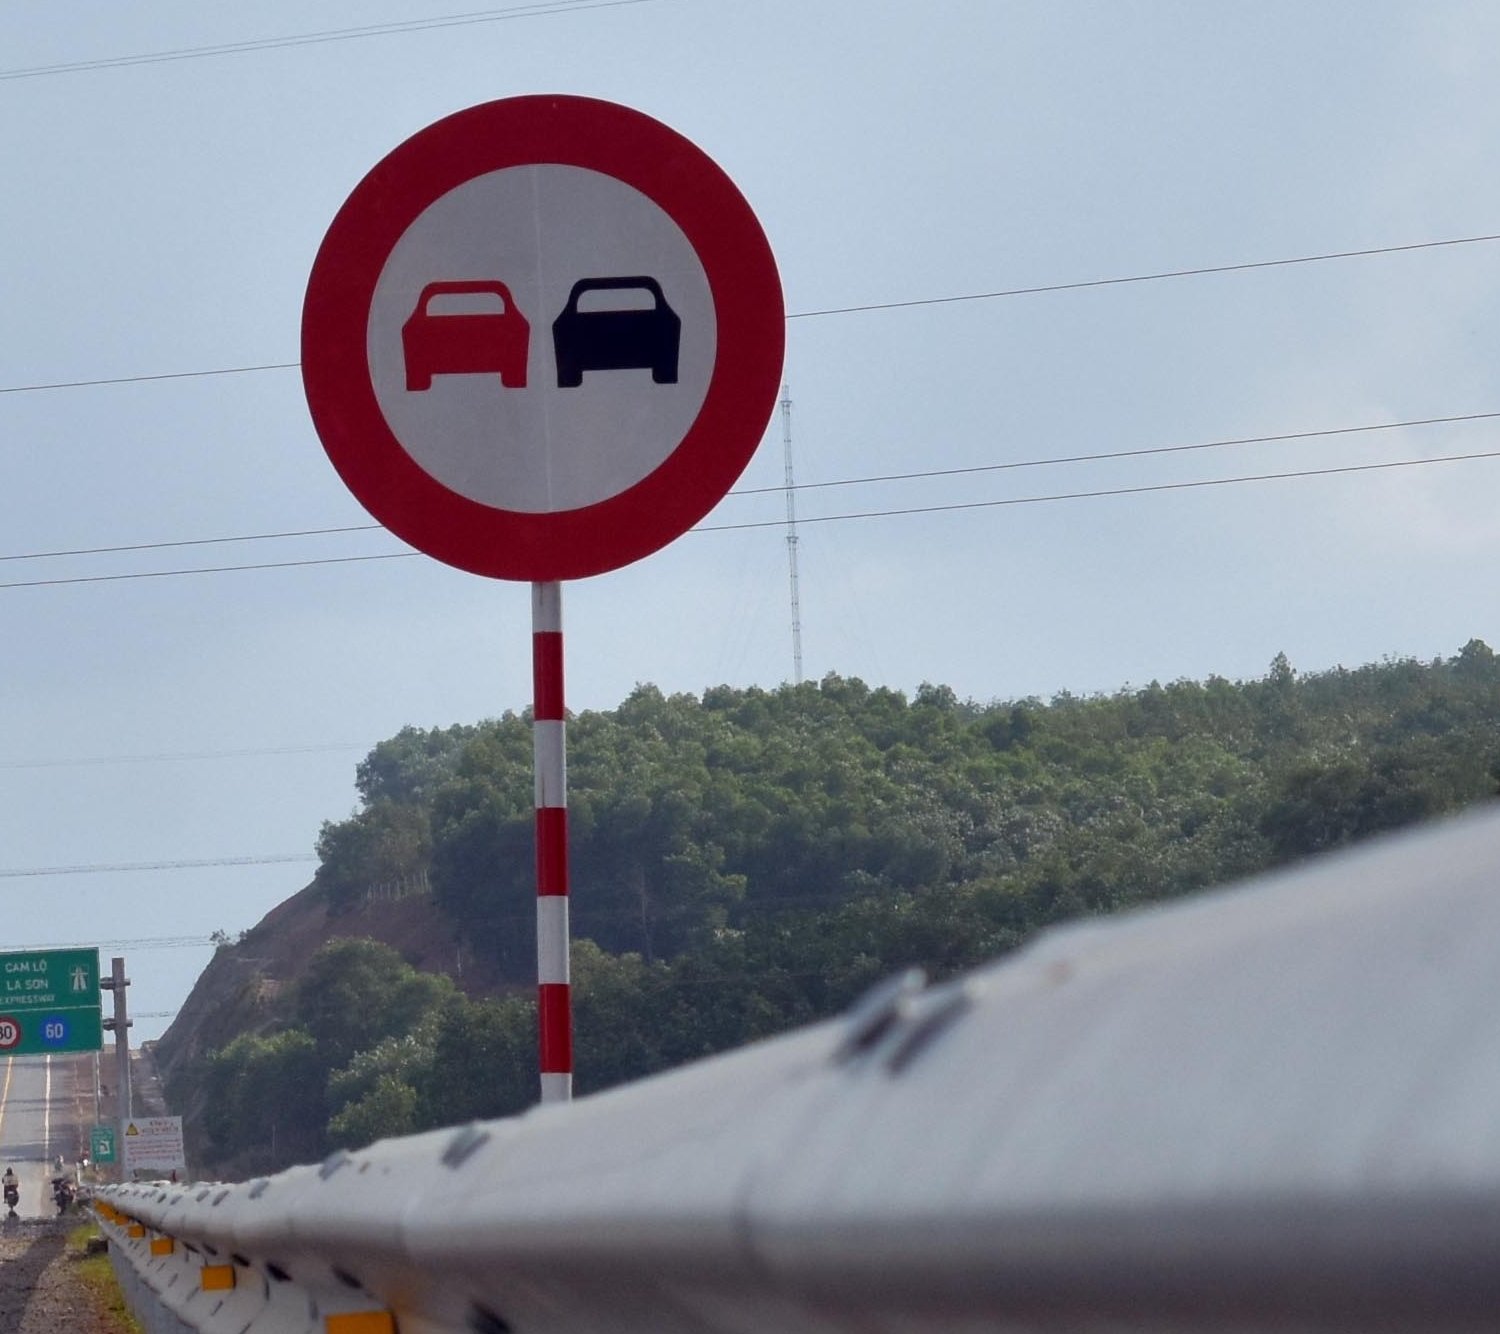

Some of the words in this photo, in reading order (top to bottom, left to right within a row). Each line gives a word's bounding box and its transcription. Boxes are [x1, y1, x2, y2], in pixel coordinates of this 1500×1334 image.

[5, 962, 30, 973] CAM
[6, 979, 21, 990] LA
[45, 1023, 64, 1039] 60
